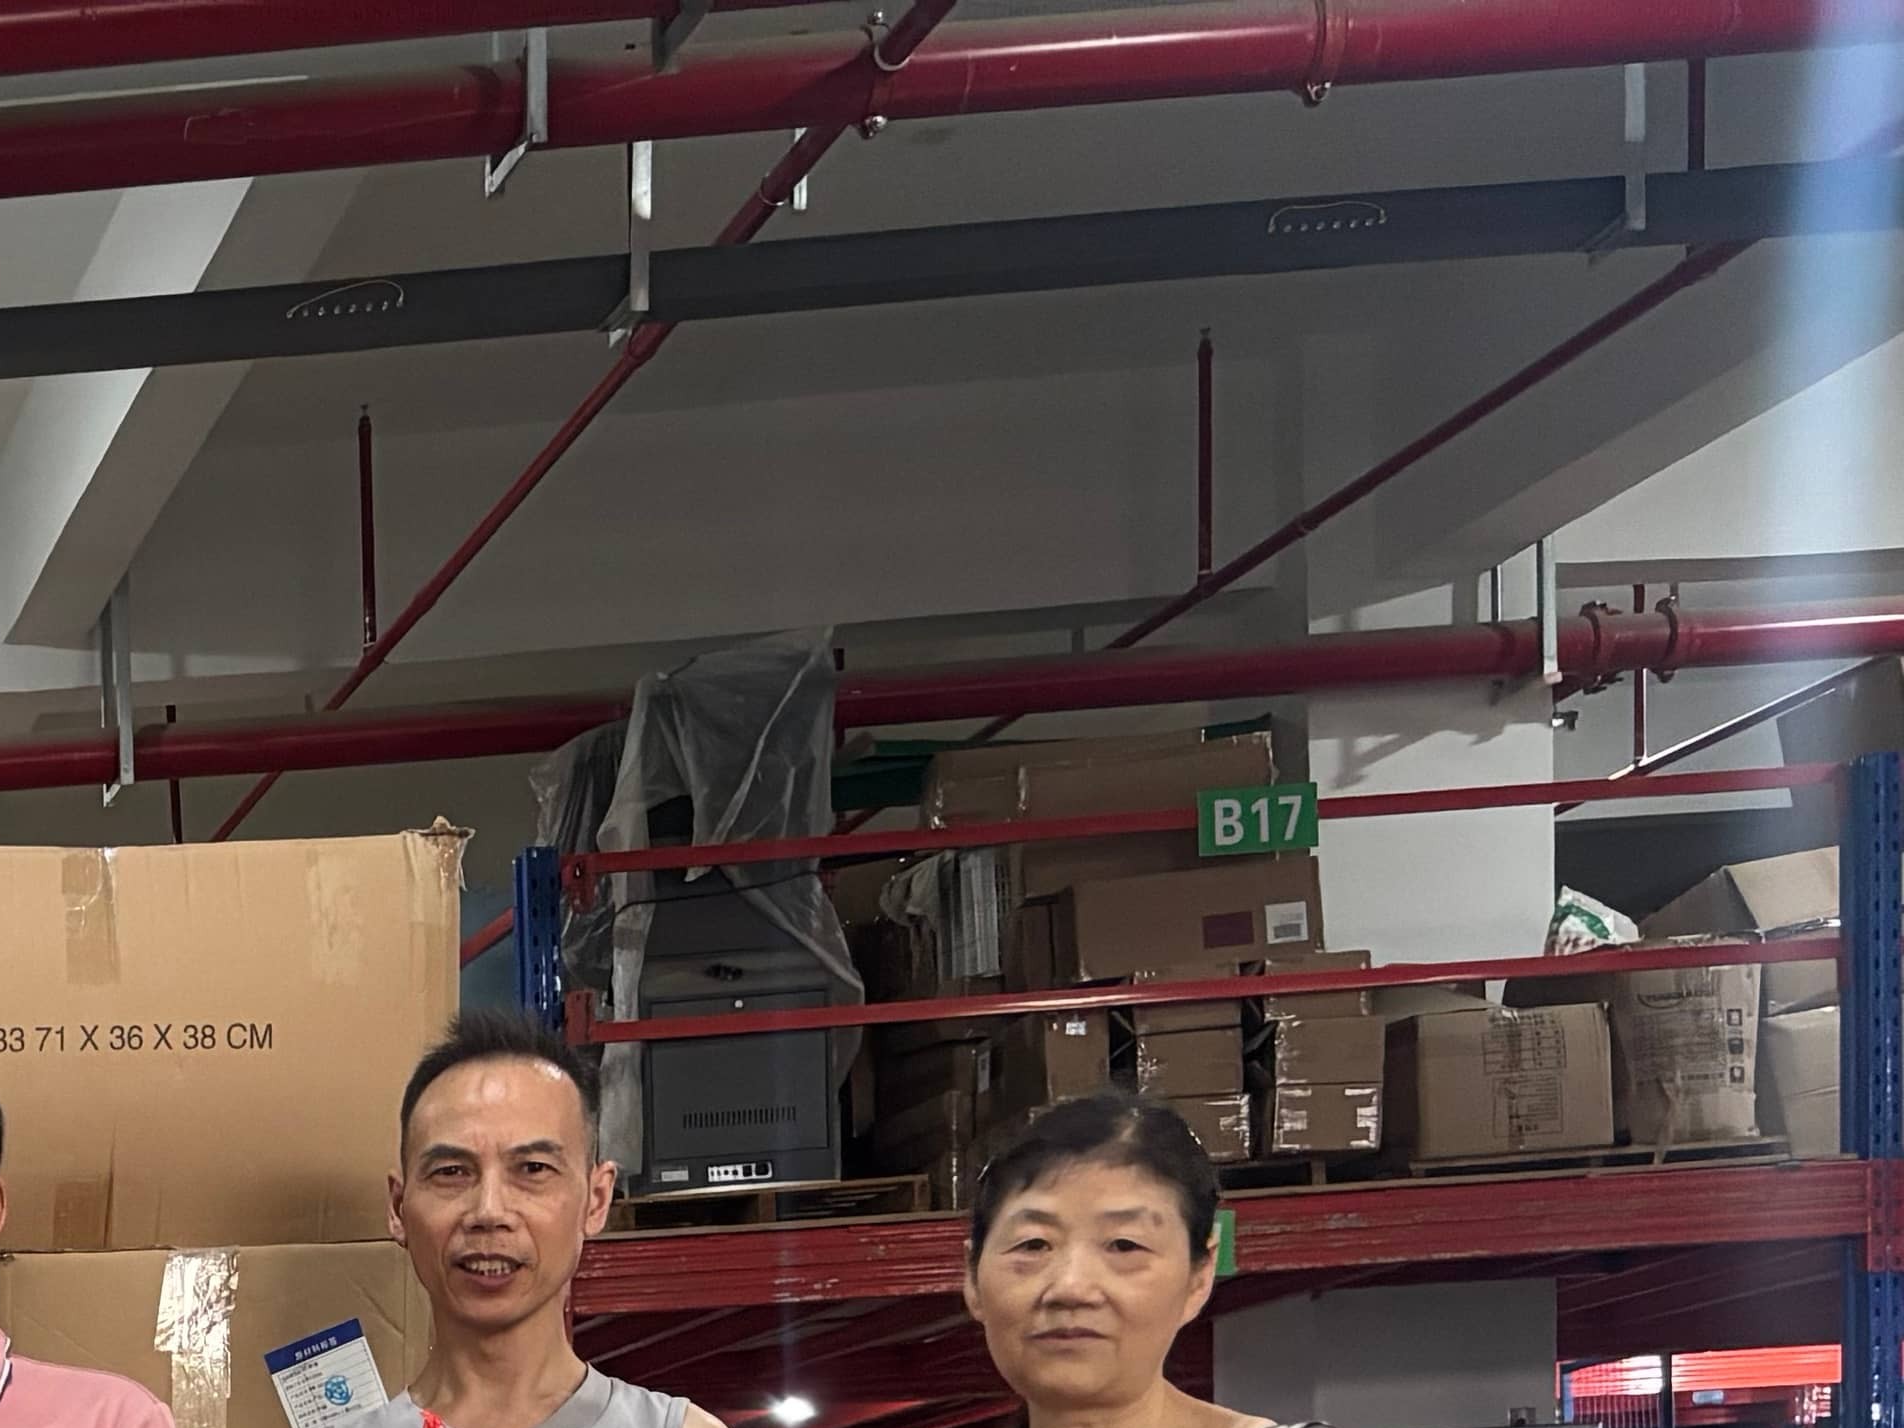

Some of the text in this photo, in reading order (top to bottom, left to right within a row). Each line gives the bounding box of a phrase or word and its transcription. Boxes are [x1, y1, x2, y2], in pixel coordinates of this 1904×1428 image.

[1212, 796, 1304, 846] B17
[35, 1026, 65, 1051] 71
[80, 1025, 99, 1050] X
[109, 1025, 143, 1050] 36
[153, 1024, 173, 1049] X
[182, 1024, 216, 1049] 38
[226, 1023, 273, 1049] CM
